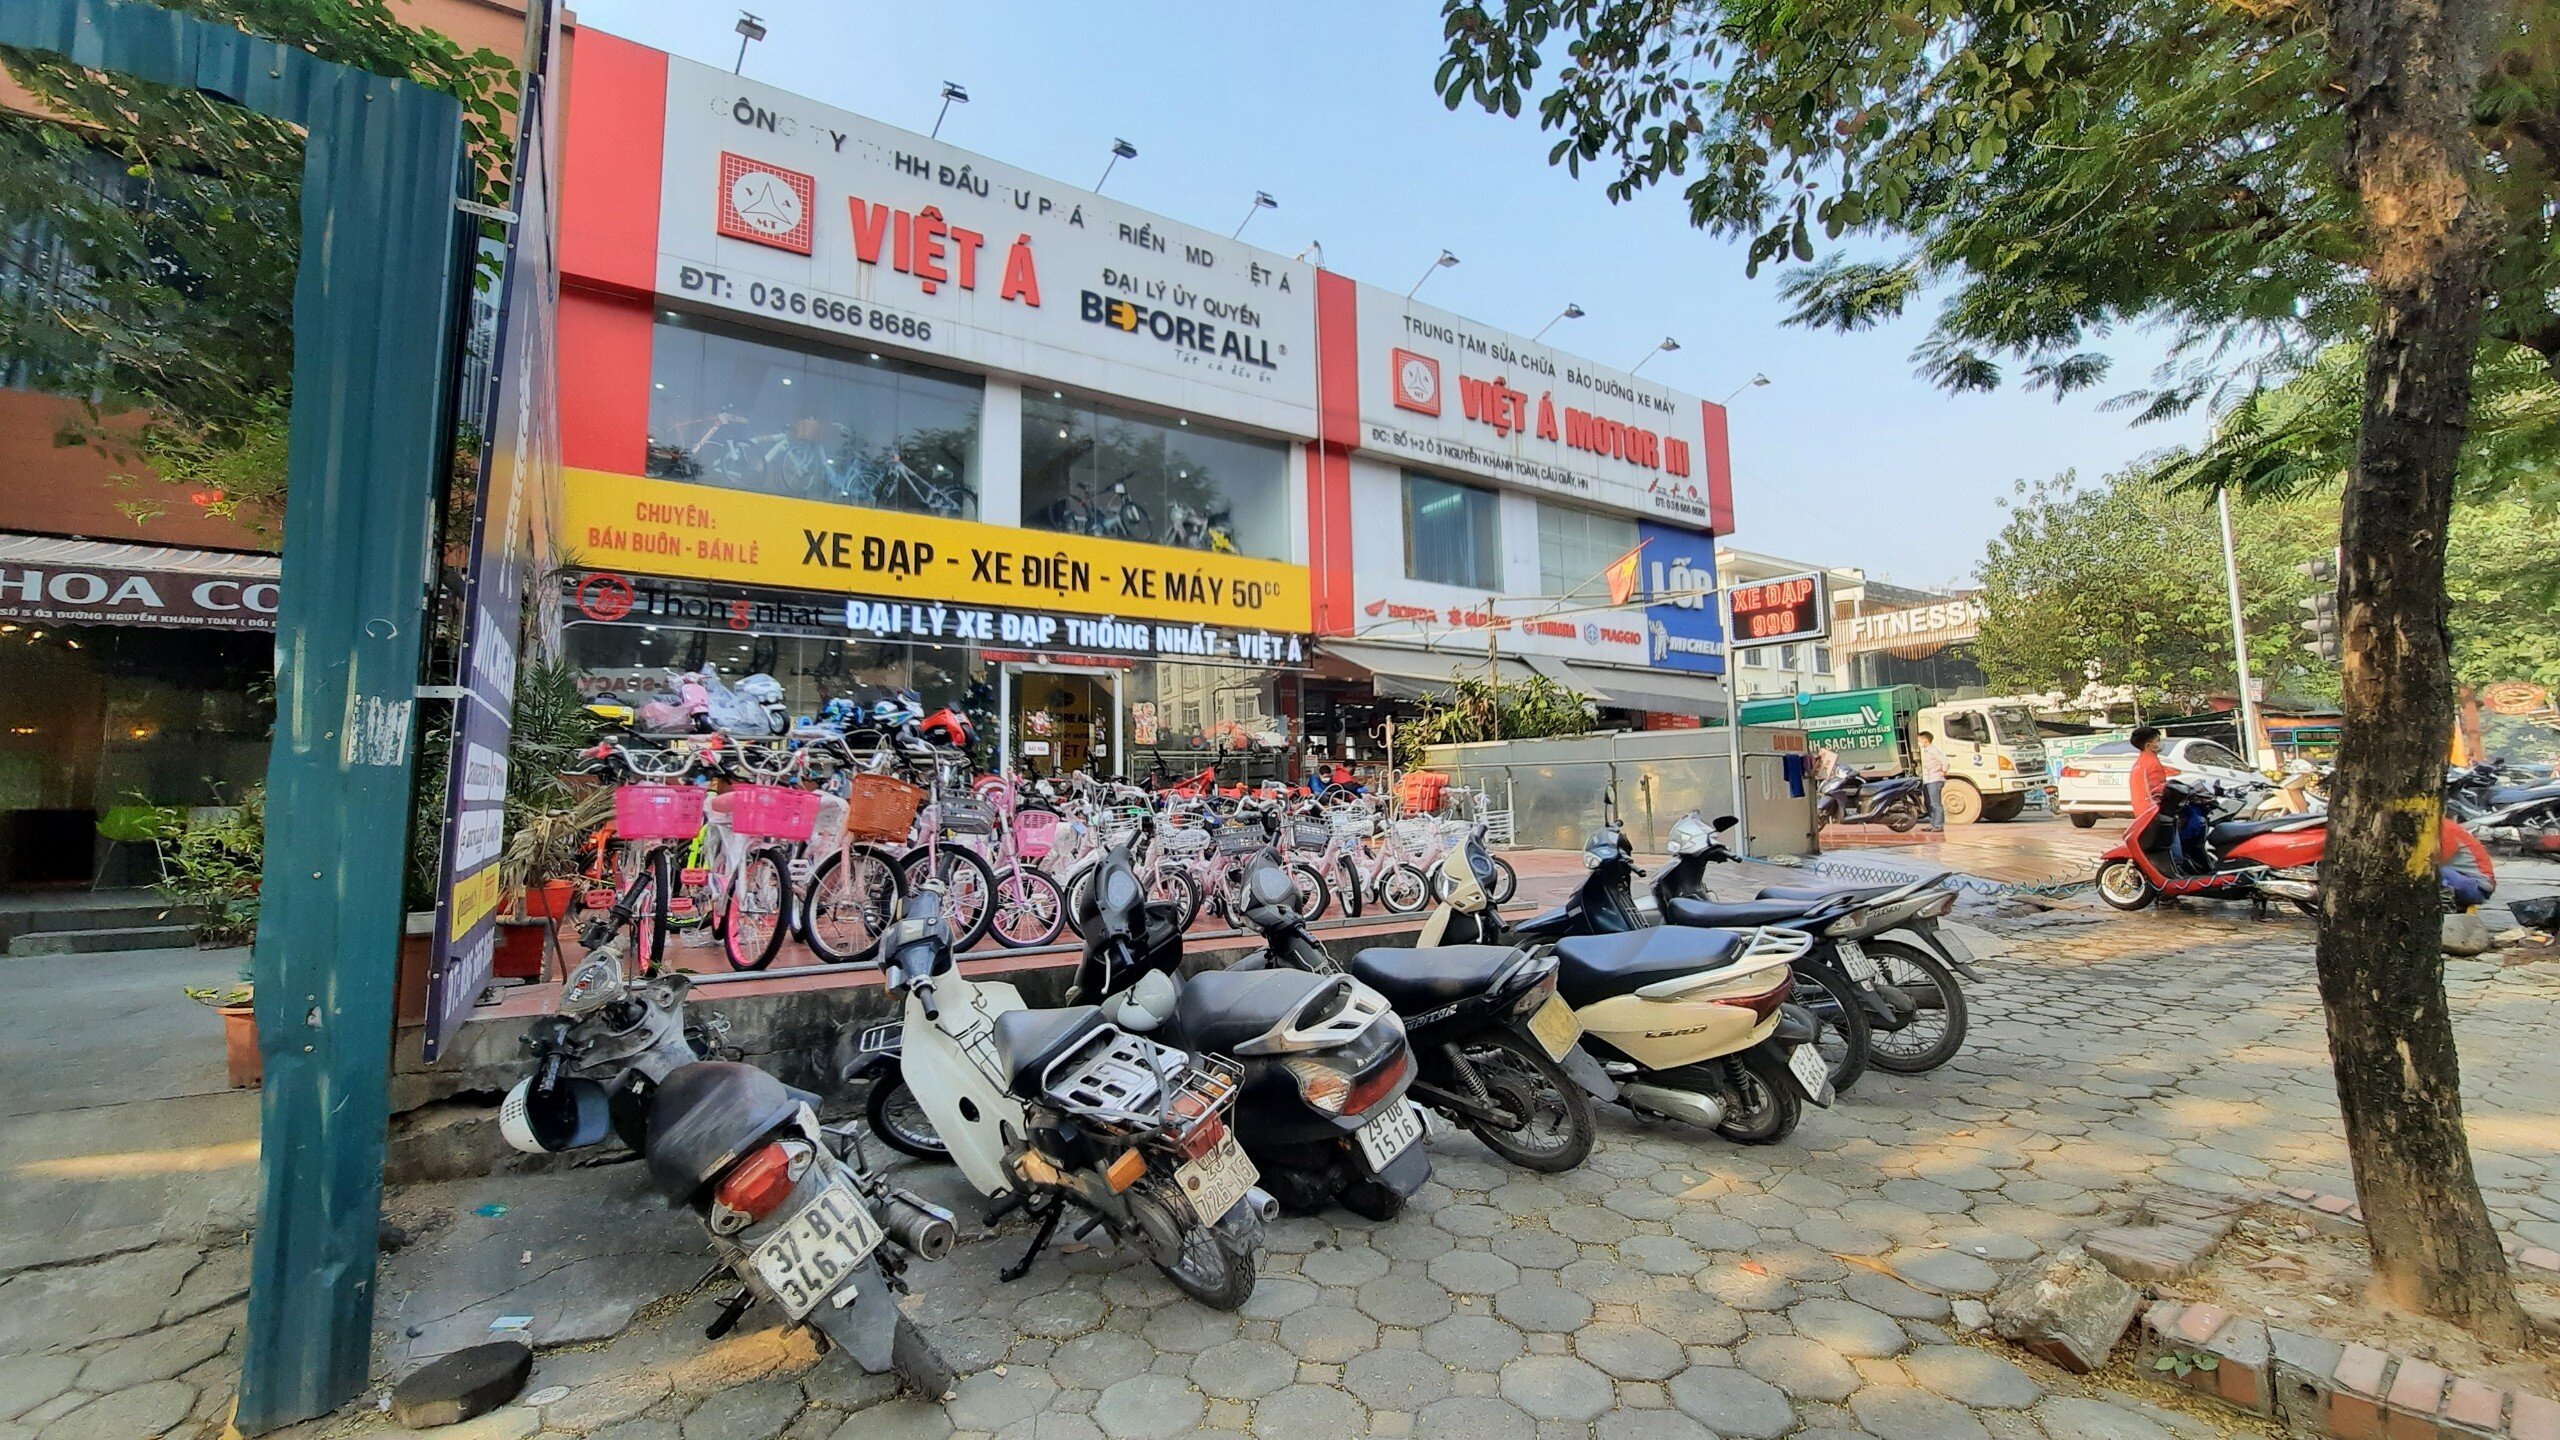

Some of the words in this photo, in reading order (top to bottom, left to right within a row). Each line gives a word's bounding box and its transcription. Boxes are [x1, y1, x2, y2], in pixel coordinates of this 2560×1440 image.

[939, 163, 989, 197] ĐẦU
[1109, 220, 1166, 254] RIỂN
[849, 196, 984, 294] VIỆT
[1001, 234, 1041, 307] Á
[680, 266, 733, 298] ĐT:
[750, 282, 807, 315] 036
[812, 298, 863, 327] 666
[868, 310, 932, 341] 8686
[1103, 268, 1138, 294] ĐẠI
[1146, 280, 1167, 301] LÝ
[1174, 284, 1197, 310] ỦY
[1081, 289, 1216, 354] BEFORE
[1221, 330, 1278, 371] ALL
[1403, 315, 1454, 344] TRUNG
[1491, 342, 1518, 366] SỬA
[1637, 392, 1651, 408] XE
[1654, 397, 1676, 416] MÁY
[1372, 428, 1391, 444] ĐC:
[1393, 430, 1408, 447] SỐ
[1437, 442, 1443, 455] 3
[1483, 454, 1514, 473] KHÁNH
[1459, 375, 1528, 437] VIỆT
[1537, 391, 1558, 442] Á
[1565, 407, 1660, 469] MOTOR
[1664, 436, 1691, 478] III
[637, 502, 716, 529] CHUYÊN:
[588, 525, 626, 551] BÁN
[632, 531, 681, 557] BUÔN
[697, 538, 734, 563] BÁN
[738, 540, 759, 565] LẺ
[802, 529, 852, 569] XE
[862, 535, 934, 581] ĐẠP
[971, 549, 1012, 585] XE
[1021, 551, 1090, 597] ĐIỆN
[1121, 566, 1156, 598] XE
[1165, 568, 1223, 606] MÁY
[1651, 557, 1713, 610] LỐP
[1733, 588, 1762, 612] XE
[1766, 579, 1812, 608] ĐẠP
[160, 614, 204, 624] KHÁNH
[207, 616, 237, 625] TOÀN
[846, 599, 902, 637] ĐẠI
[911, 602, 947, 636] LÝ
[955, 609, 993, 640] XE
[1001, 612, 1057, 647] ĐẠP
[1065, 614, 1149, 650] THỐNG
[1156, 623, 1218, 655] NHẤT
[1238, 631, 1284, 664] VIỆT
[1287, 633, 1302, 662] Á
[1600, 628, 1641, 645] PIAGGIO
[1752, 610, 1796, 637] 999
[1825, 736, 1856, 752] SẠCH
[1859, 734, 1884, 750] ĐẸP
[1974, 754, 1984, 767] 2
[1645, 1024, 1708, 1038] LEAD
[1375, 1119, 1414, 1161] 1516
[1195, 1154, 1255, 1220] 726-N5
[767, 1197, 844, 1274] 37-B1
[782, 1215, 869, 1308] 346.17
